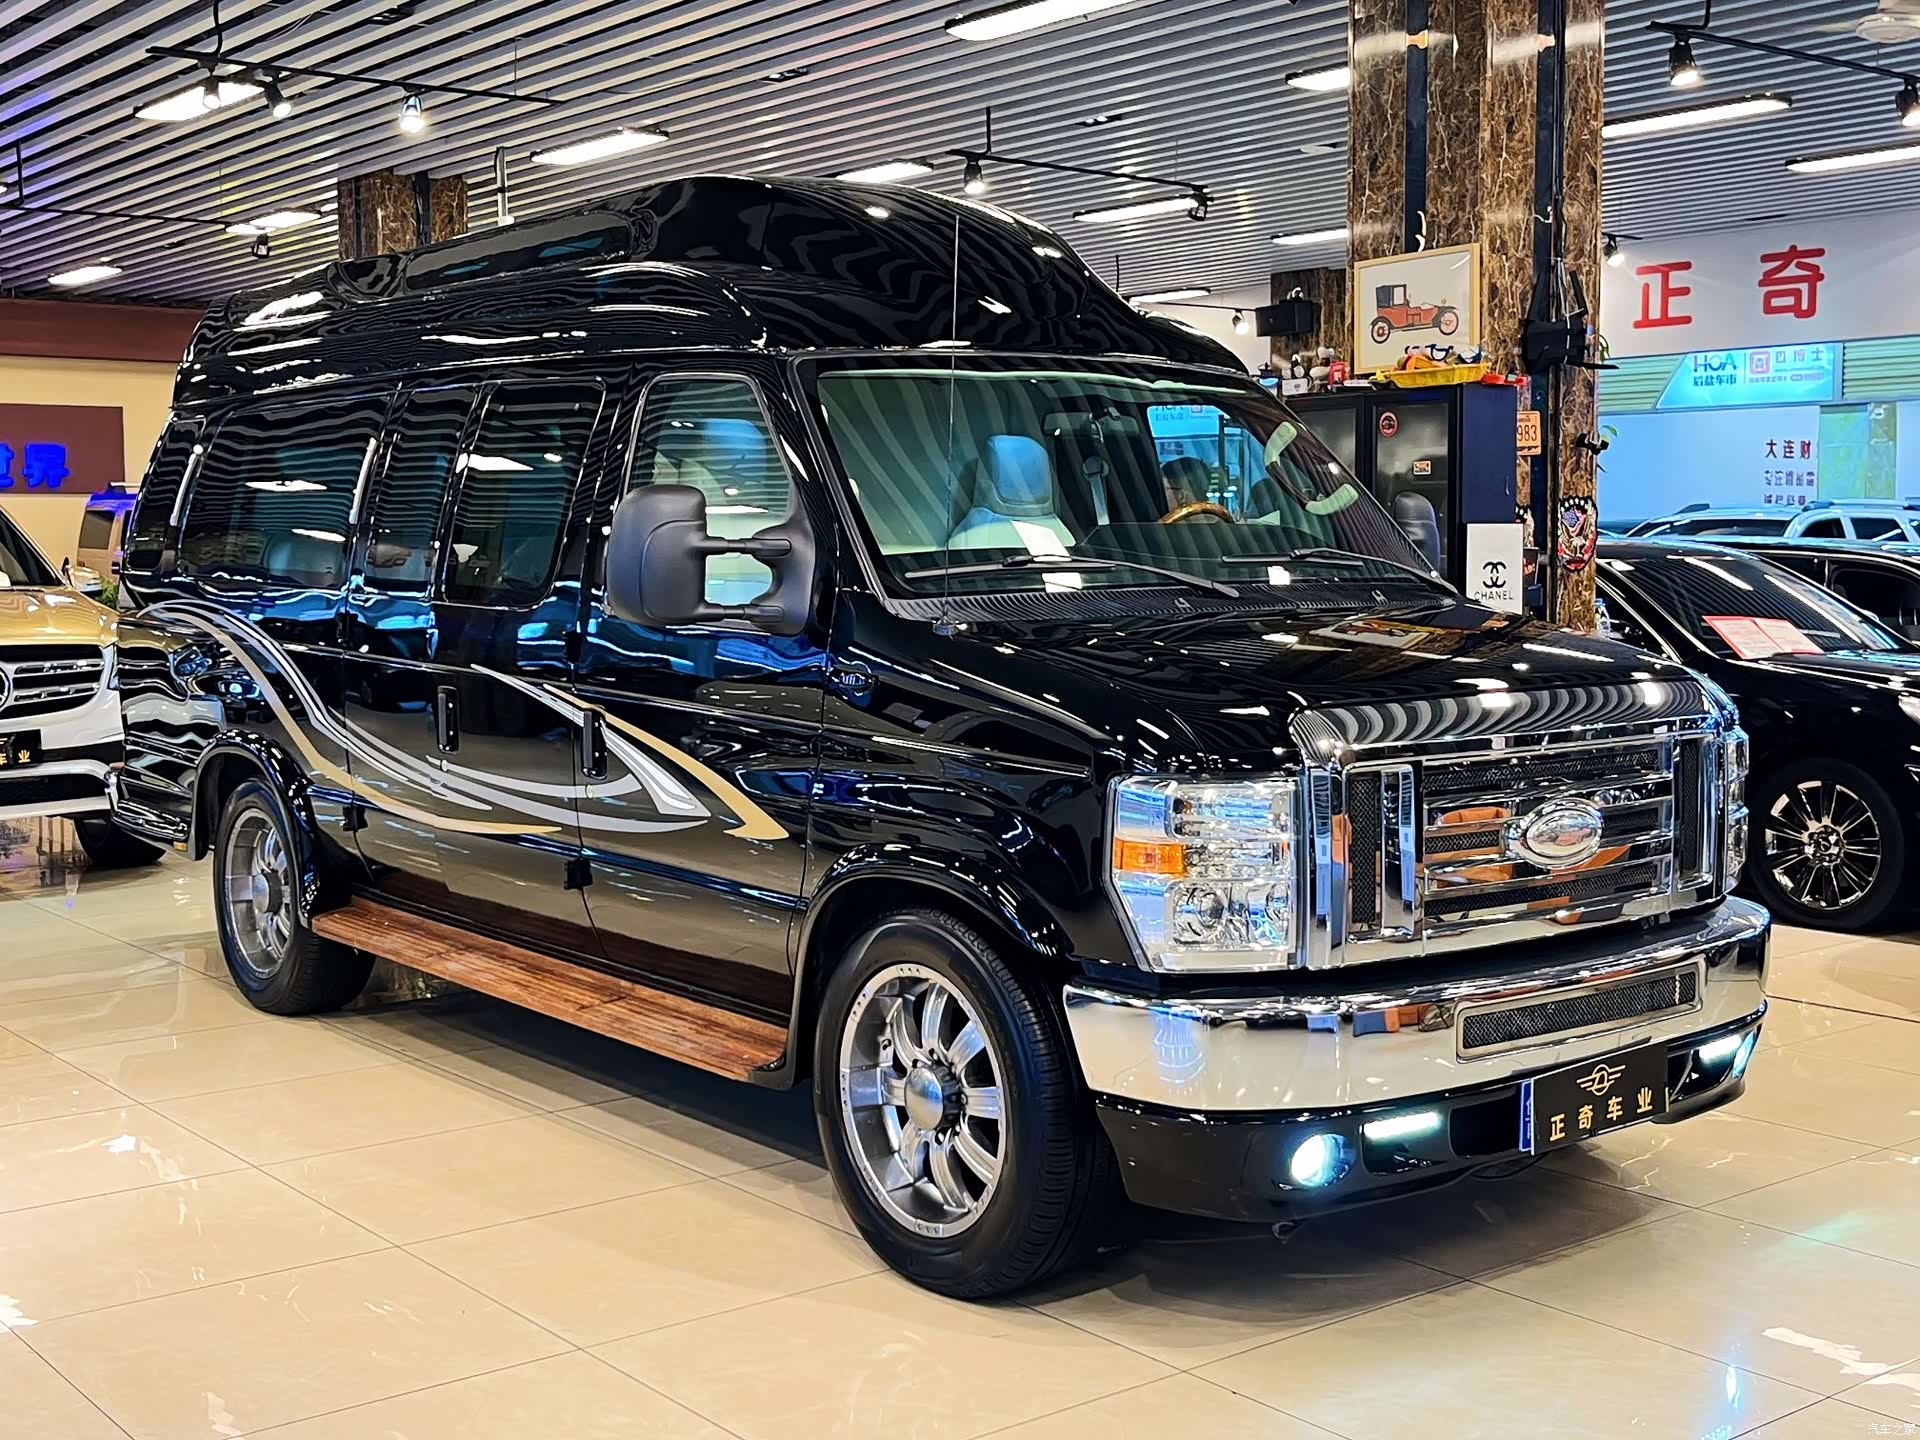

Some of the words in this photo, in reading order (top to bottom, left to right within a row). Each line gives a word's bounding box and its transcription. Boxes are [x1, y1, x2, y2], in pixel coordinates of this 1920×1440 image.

[1633, 244, 1826, 330] 正奇
[1516, 424, 1537, 442] 983
[1474, 590, 1514, 601] CHANEL
[1550, 1086, 1653, 1142] 正奇车业
